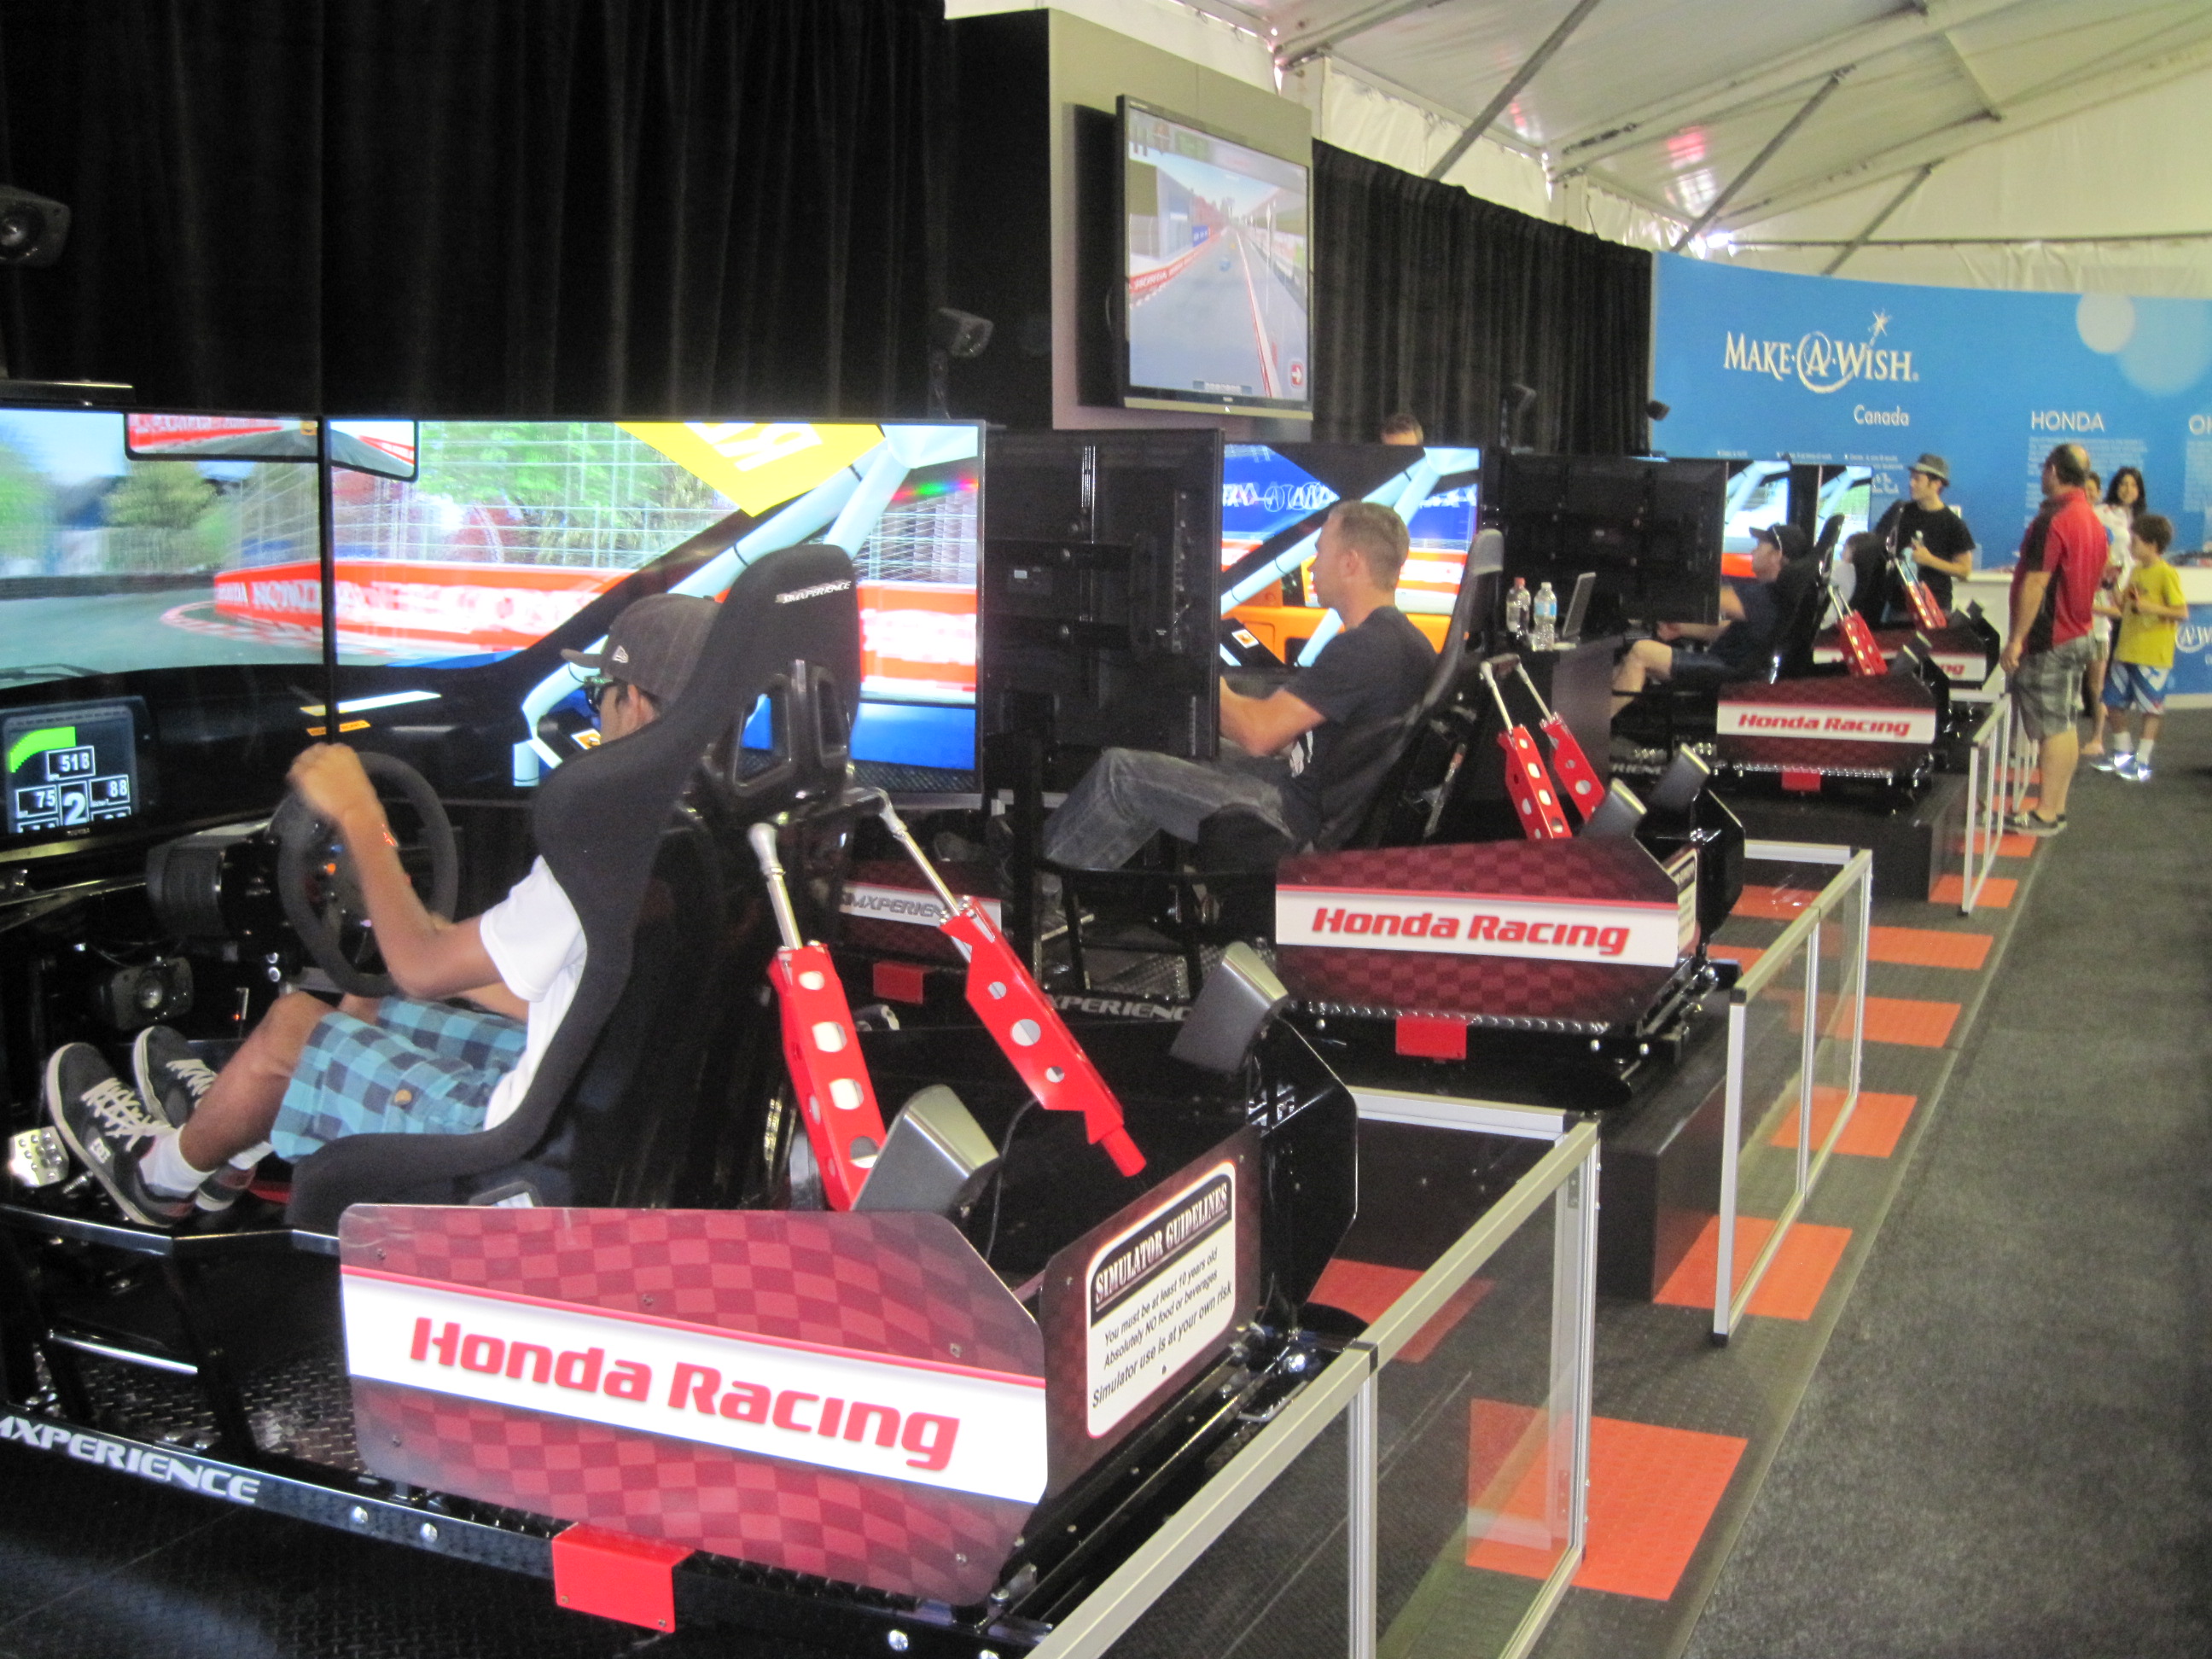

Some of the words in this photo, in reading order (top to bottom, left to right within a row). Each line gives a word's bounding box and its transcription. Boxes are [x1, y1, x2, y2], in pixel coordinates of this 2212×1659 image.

[1854, 405, 1910, 426] Canada
[2030, 410, 2105, 432] HONDA
[1738, 713, 1820, 731] Honda
[1824, 717, 1911, 737] Racing
[60, 752, 90, 772] 518
[36, 789, 57, 808] 75
[108, 779, 128, 797] 88
[62, 792, 87, 825] 2
[1312, 907, 1459, 939] Honda
[1468, 915, 1631, 956] Racing
[1096, 1230, 1163, 1304] SIMULATOR
[1166, 1182, 1227, 1250] GUIDELINES
[1104, 1326, 1119, 1346] You
[1121, 1309, 1140, 1334] must
[1141, 1302, 1150, 1318] be
[1152, 1294, 1160, 1310] at
[1161, 1279, 1177, 1304] least
[1179, 1272, 1187, 1289] 10
[1187, 1260, 1206, 1285] years
[1207, 1247, 1218, 1264] old
[1104, 1329, 1144, 1370] Absolutely
[1145, 1315, 1157, 1336] NO
[1158, 1301, 1175, 1326] food
[1175, 1297, 1184, 1311] or
[1185, 1269, 1218, 1304] beverages
[1092, 1359, 1138, 1408] Simulator
[1139, 1346, 1156, 1369] use
[1158, 1337, 1166, 1354] is
[1168, 1326, 1177, 1347] at
[1178, 1311, 1197, 1342] your
[1199, 1297, 1216, 1319] own
[1218, 1280, 1232, 1305] risk
[410, 1317, 652, 1402] Honda
[667, 1361, 961, 1471] Racing
